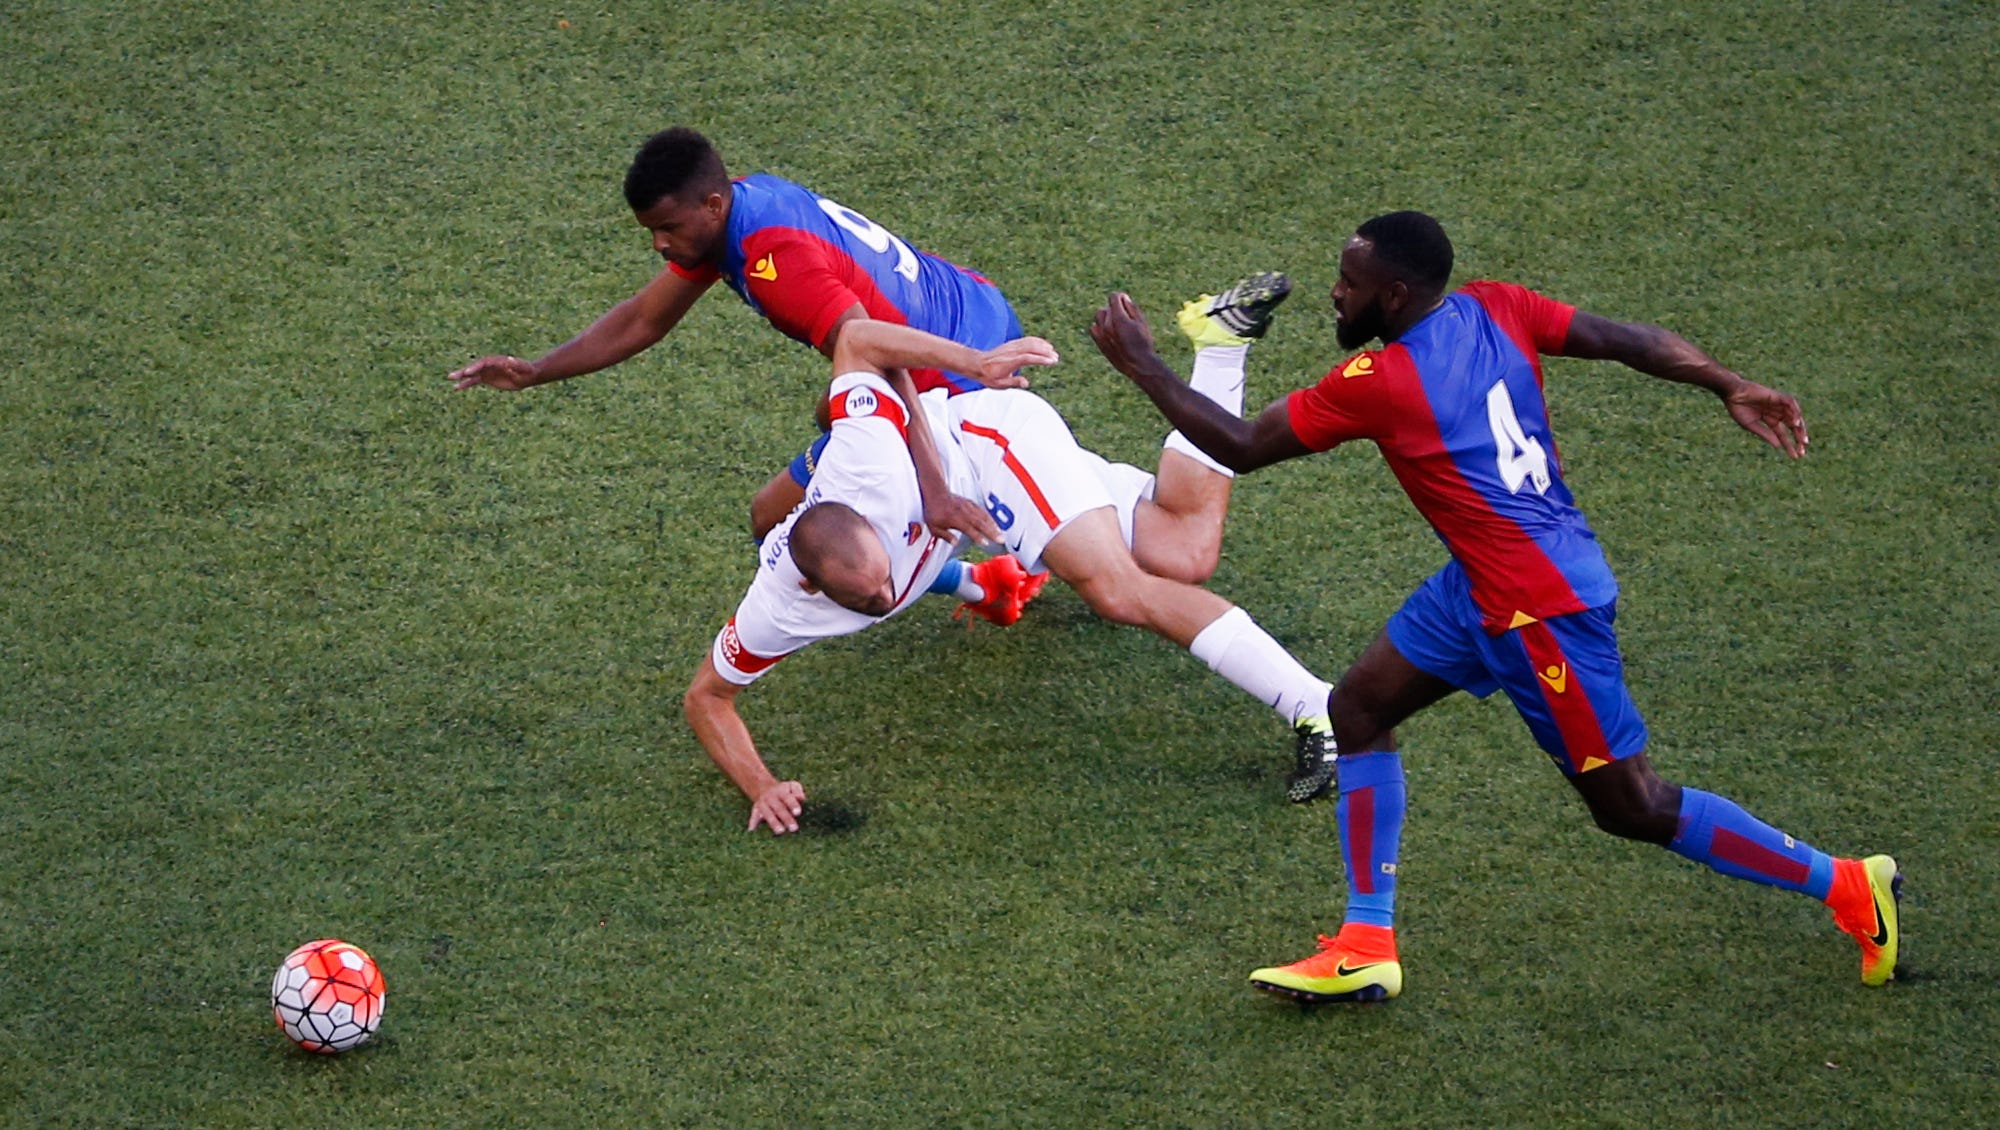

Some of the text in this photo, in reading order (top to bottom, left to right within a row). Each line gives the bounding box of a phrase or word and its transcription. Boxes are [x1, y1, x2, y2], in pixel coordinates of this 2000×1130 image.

[816, 198, 919, 283] 9
[849, 395, 874, 409] USL
[1486, 378, 1552, 495] 4
[986, 491, 1015, 531] 8
